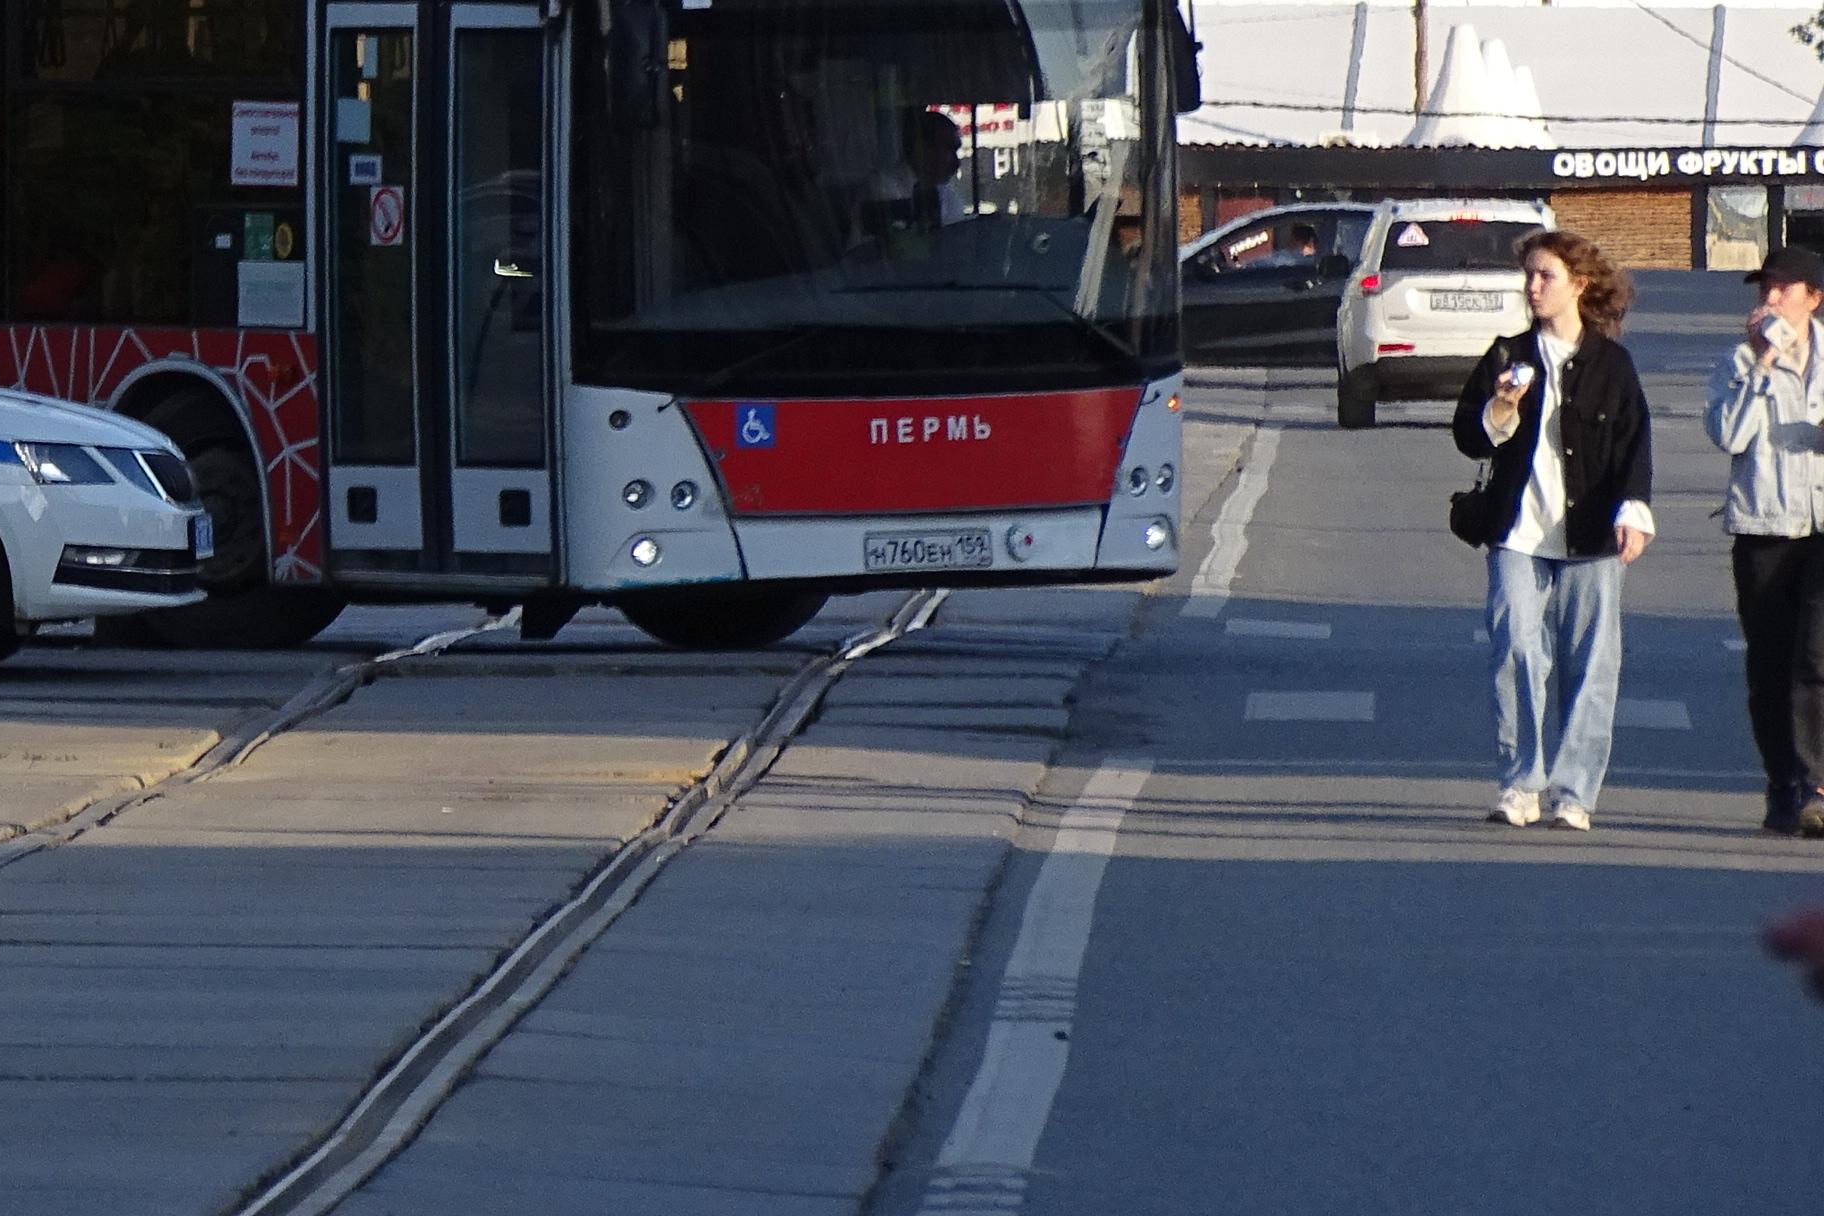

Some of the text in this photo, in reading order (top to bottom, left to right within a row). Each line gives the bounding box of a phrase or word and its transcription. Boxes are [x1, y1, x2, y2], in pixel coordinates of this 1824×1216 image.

[1553, 151, 1671, 181] ОВОЩИ
[1677, 150, 1807, 176] ФРУКТЫ
[870, 414, 992, 444] ПЕРМЬ
